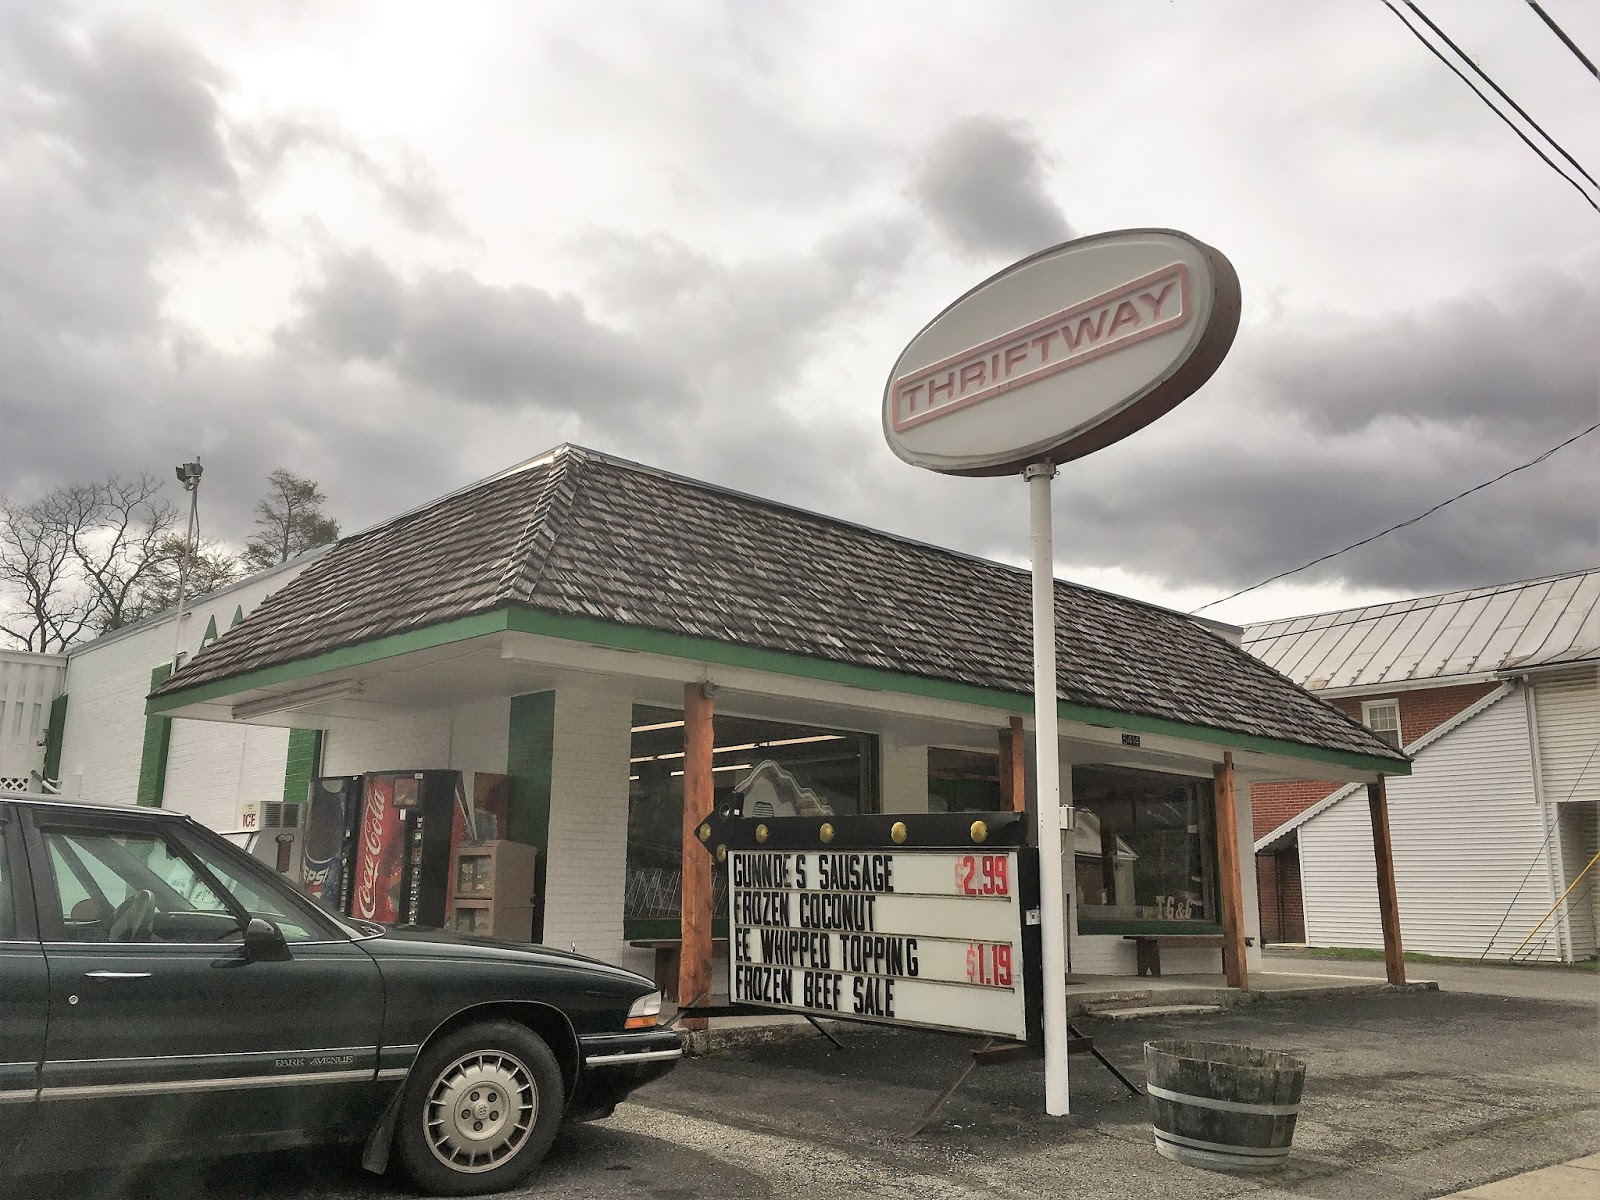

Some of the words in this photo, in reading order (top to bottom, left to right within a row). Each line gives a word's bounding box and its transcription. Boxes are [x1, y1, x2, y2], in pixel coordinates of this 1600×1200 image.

[902, 282, 1176, 414] THRIFTWAY
[242, 813, 256, 828] ICE
[819, 854, 894, 892] SAUSAGE
[734, 890, 790, 927] FROZEN
[800, 892, 876, 932] COCONUT
[760, 929, 830, 969] WHIPPED
[840, 934, 919, 977] TOPPING
[966, 943, 1012, 986] $1.19
[735, 964, 793, 1004] FROZEN
[803, 971, 842, 1011] BEEF
[853, 975, 895, 1018] SALE
[275, 1058, 305, 1067] PARK
[309, 1055, 354, 1065] AVENUE
